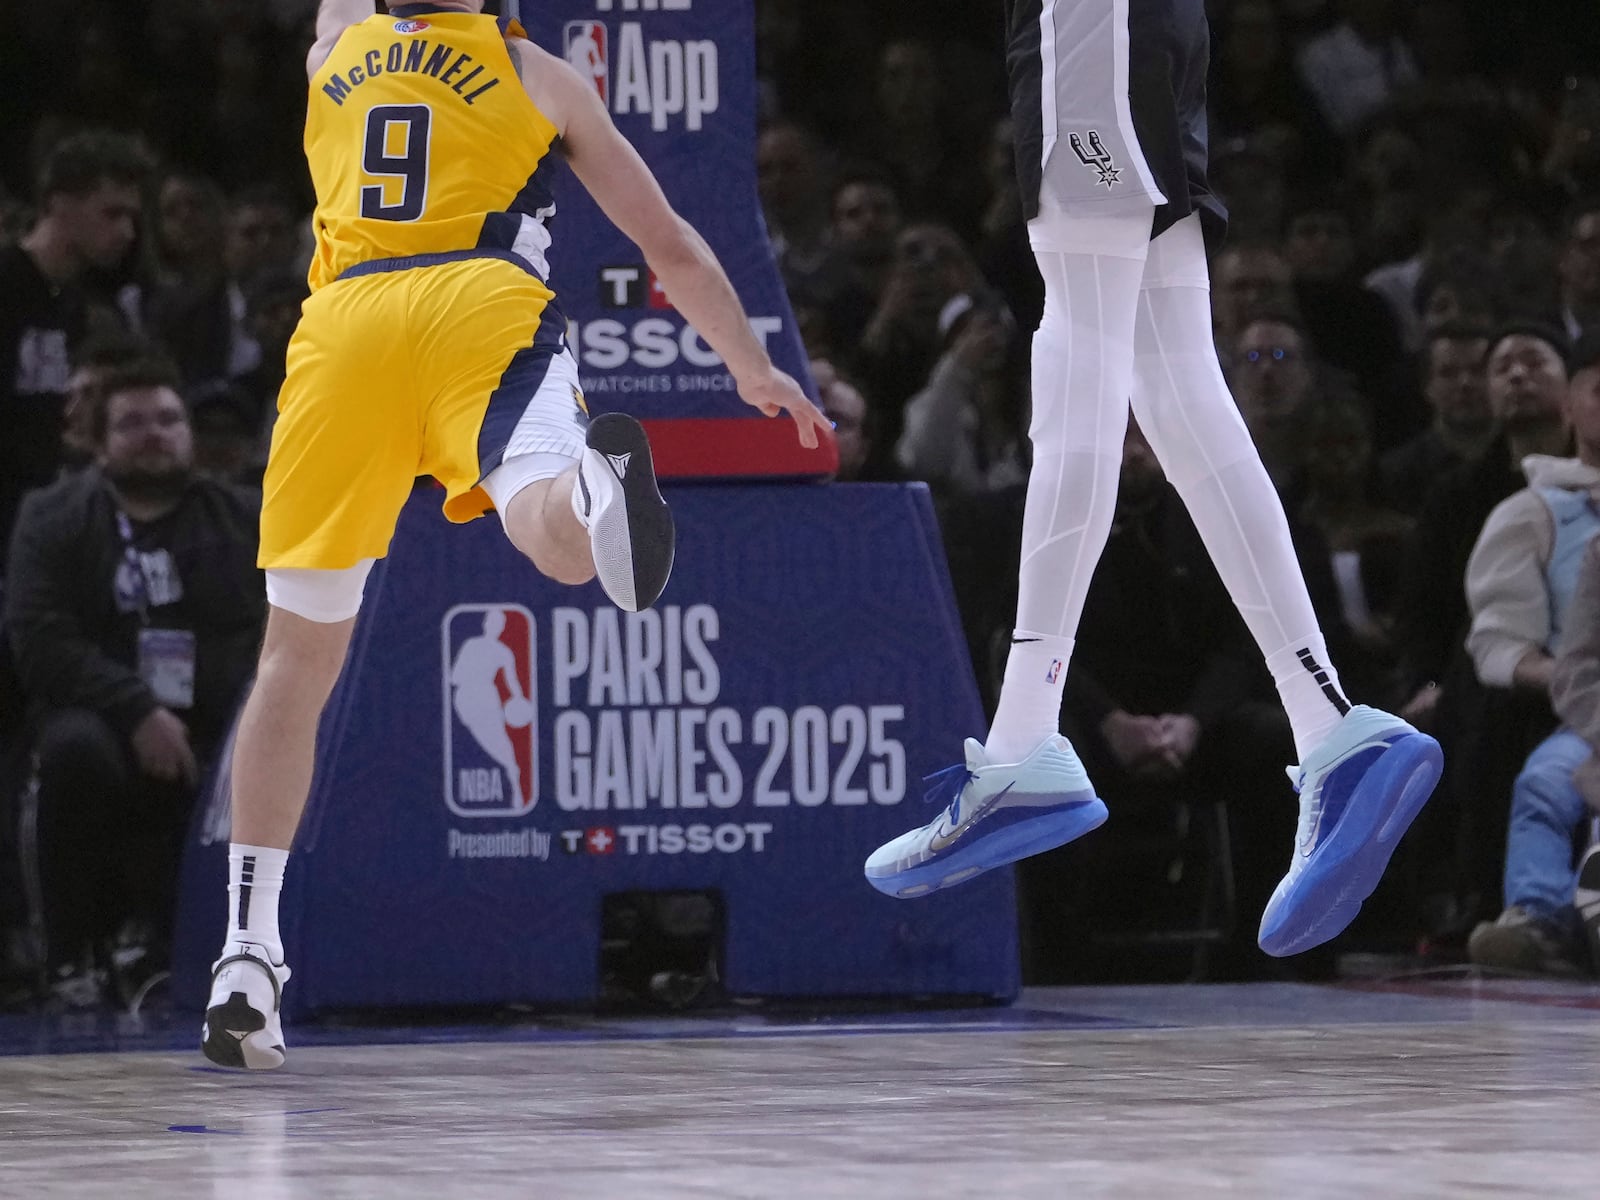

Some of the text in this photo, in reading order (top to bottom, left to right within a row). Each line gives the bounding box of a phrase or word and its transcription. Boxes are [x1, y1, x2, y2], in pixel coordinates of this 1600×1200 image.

[322, 39, 499, 106] McCONNELL
[613, 21, 719, 132] App
[359, 103, 432, 223] 9
[566, 316, 783, 369] ISSOT
[580, 375, 672, 393] WATCHES
[552, 604, 721, 707] PARIS
[459, 767, 504, 803] NBA
[554, 704, 907, 812] GAMES 2025
[448, 828, 531, 860] Presented
[532, 827, 551, 862] by
[619, 823, 773, 855] TISSOT
